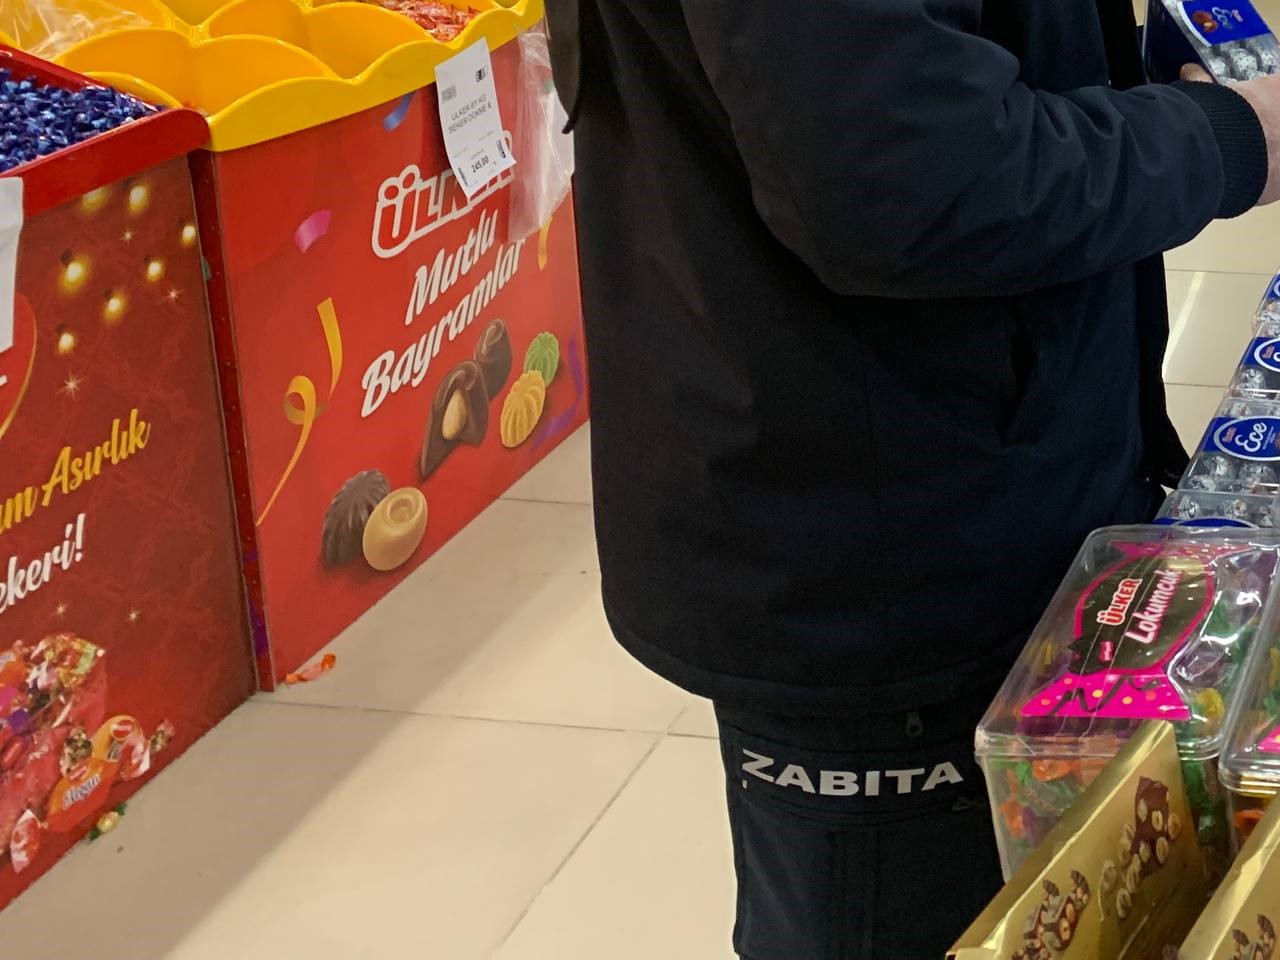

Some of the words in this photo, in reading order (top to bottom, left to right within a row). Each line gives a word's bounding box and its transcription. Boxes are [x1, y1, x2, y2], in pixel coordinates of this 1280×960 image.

[405, 209, 498, 326] Mutlu
[362, 237, 525, 418] Bayramlar
[42, 408, 150, 507] Asırlık
[1235, 421, 1267, 453] Ece
[0, 513, 86, 614] ekeri!
[1096, 578, 1143, 626] ÜLKER
[1124, 569, 1183, 645] Lokumcuk
[742, 747, 964, 797] ZABITA
